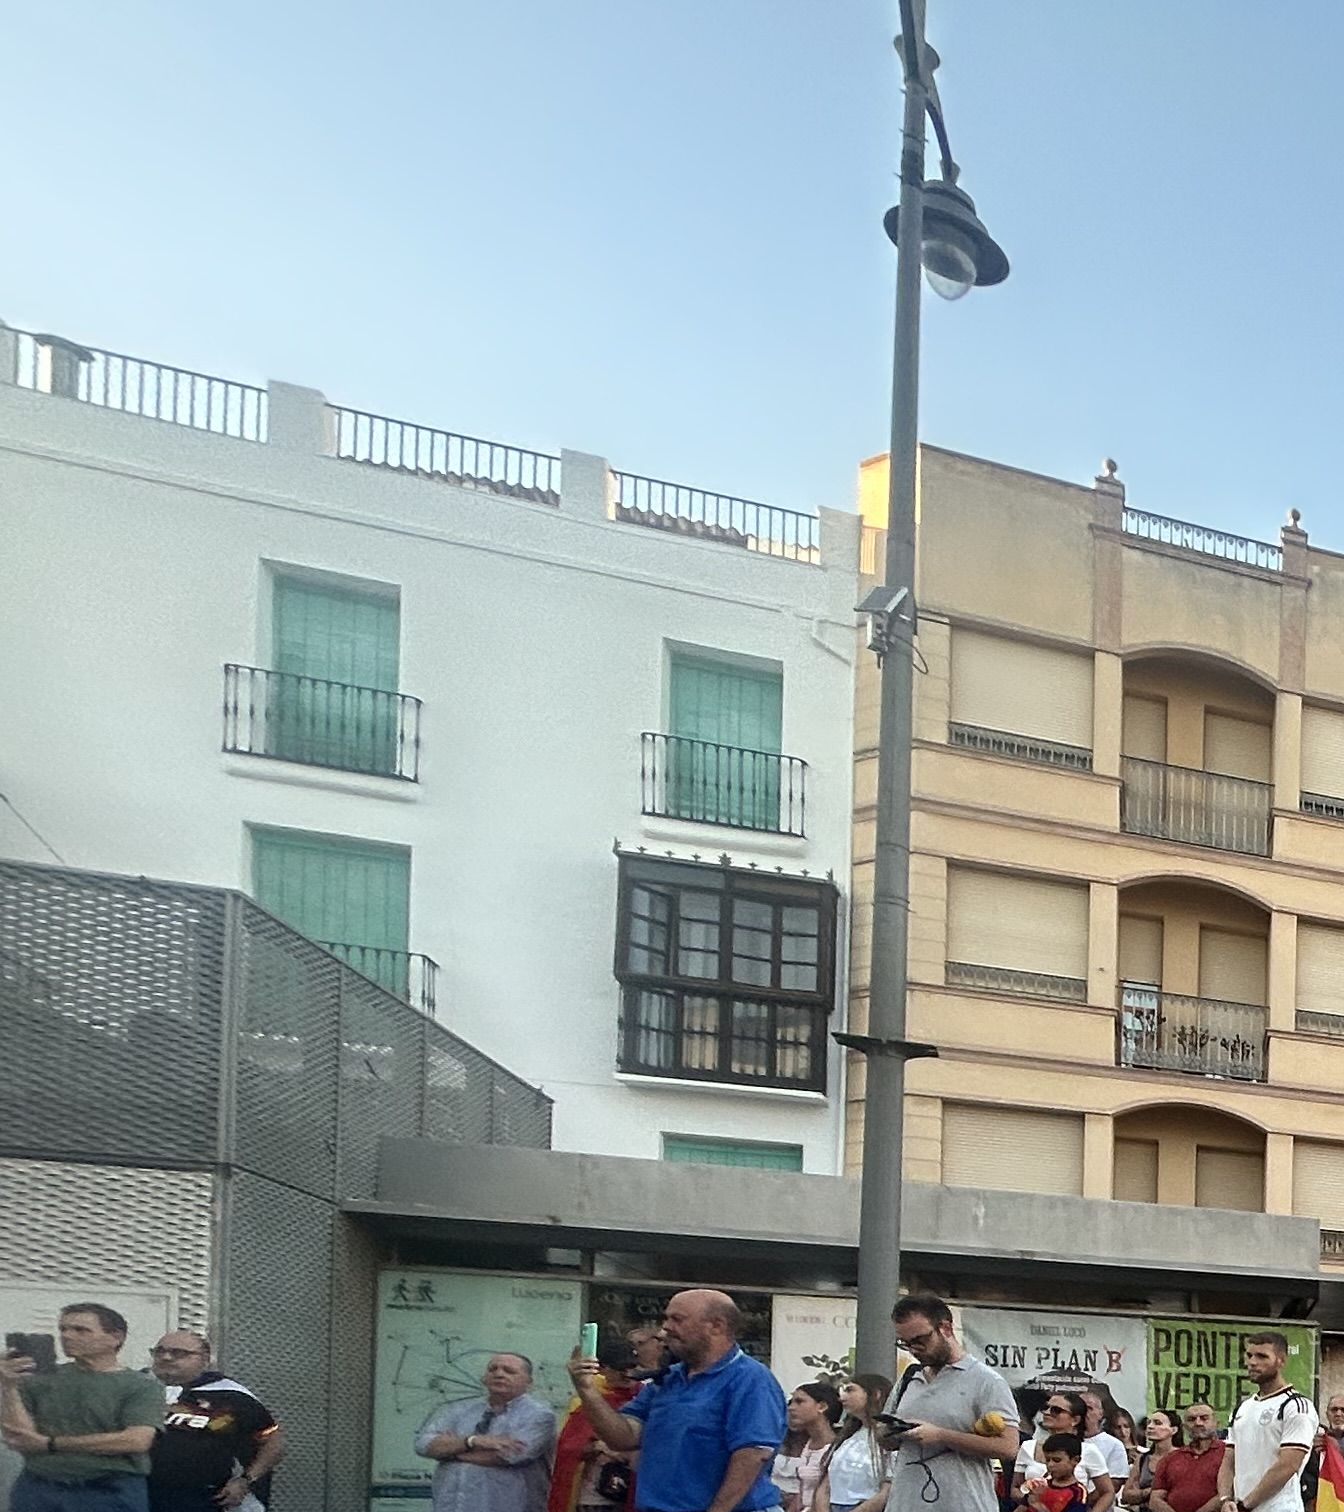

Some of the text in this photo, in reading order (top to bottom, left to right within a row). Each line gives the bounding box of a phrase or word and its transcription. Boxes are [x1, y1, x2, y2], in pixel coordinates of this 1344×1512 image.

[984, 1343, 1124, 1375] SIN PLAN B
[1152, 1327, 1250, 1370] PONTE
[1152, 1371, 1250, 1412] VERDE
